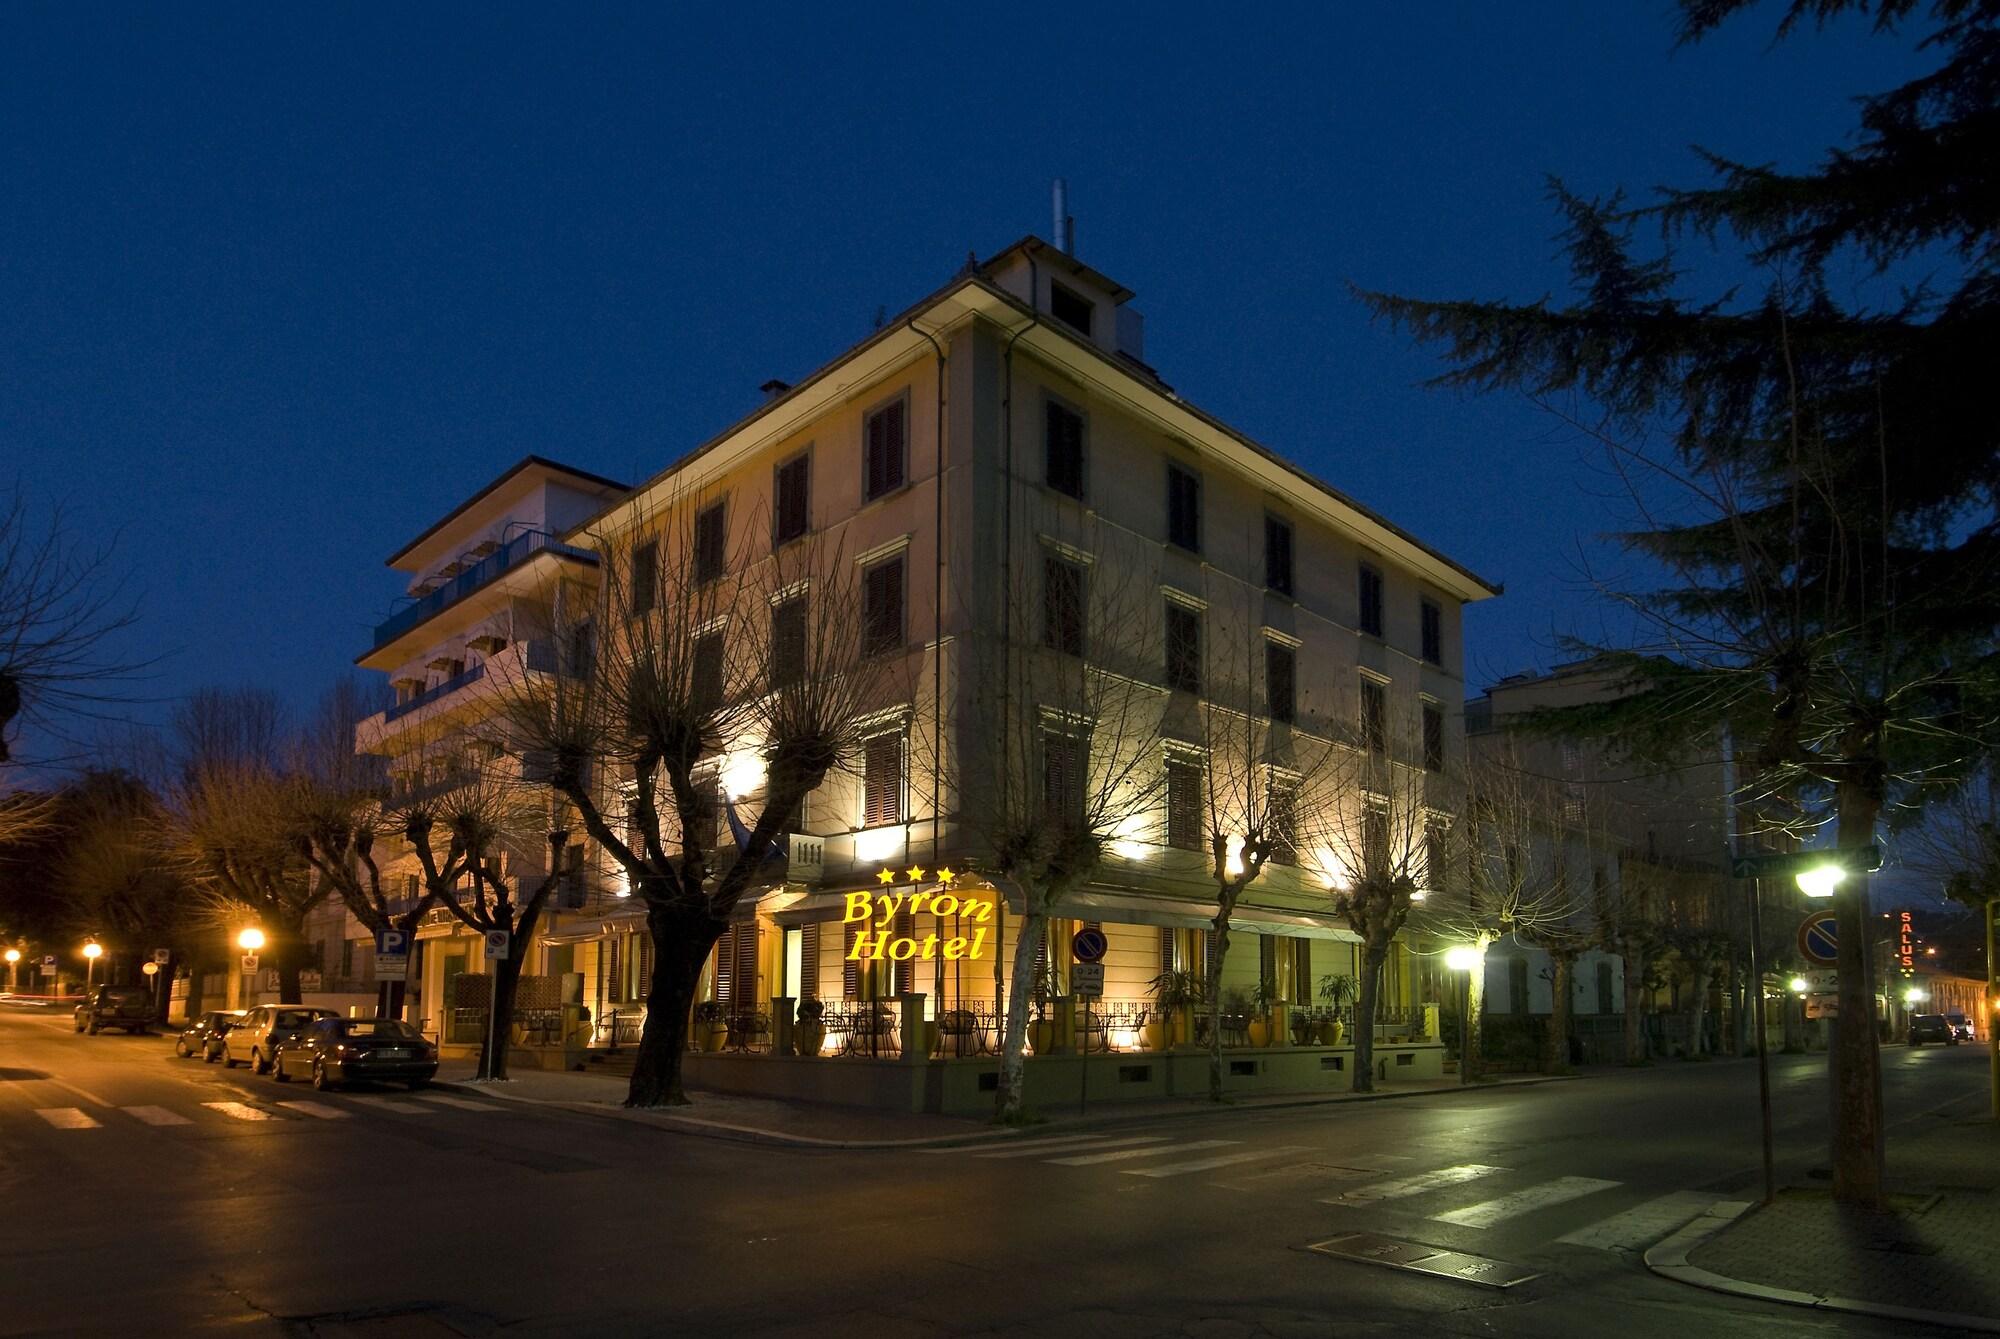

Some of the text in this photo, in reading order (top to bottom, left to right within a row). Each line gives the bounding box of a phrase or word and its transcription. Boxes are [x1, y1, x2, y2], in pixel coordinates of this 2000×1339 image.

[841, 890, 993, 927] Byron
[382, 931, 403, 953] P
[845, 927, 987, 960] Hotel
[1901, 912, 1913, 966] SALUS
